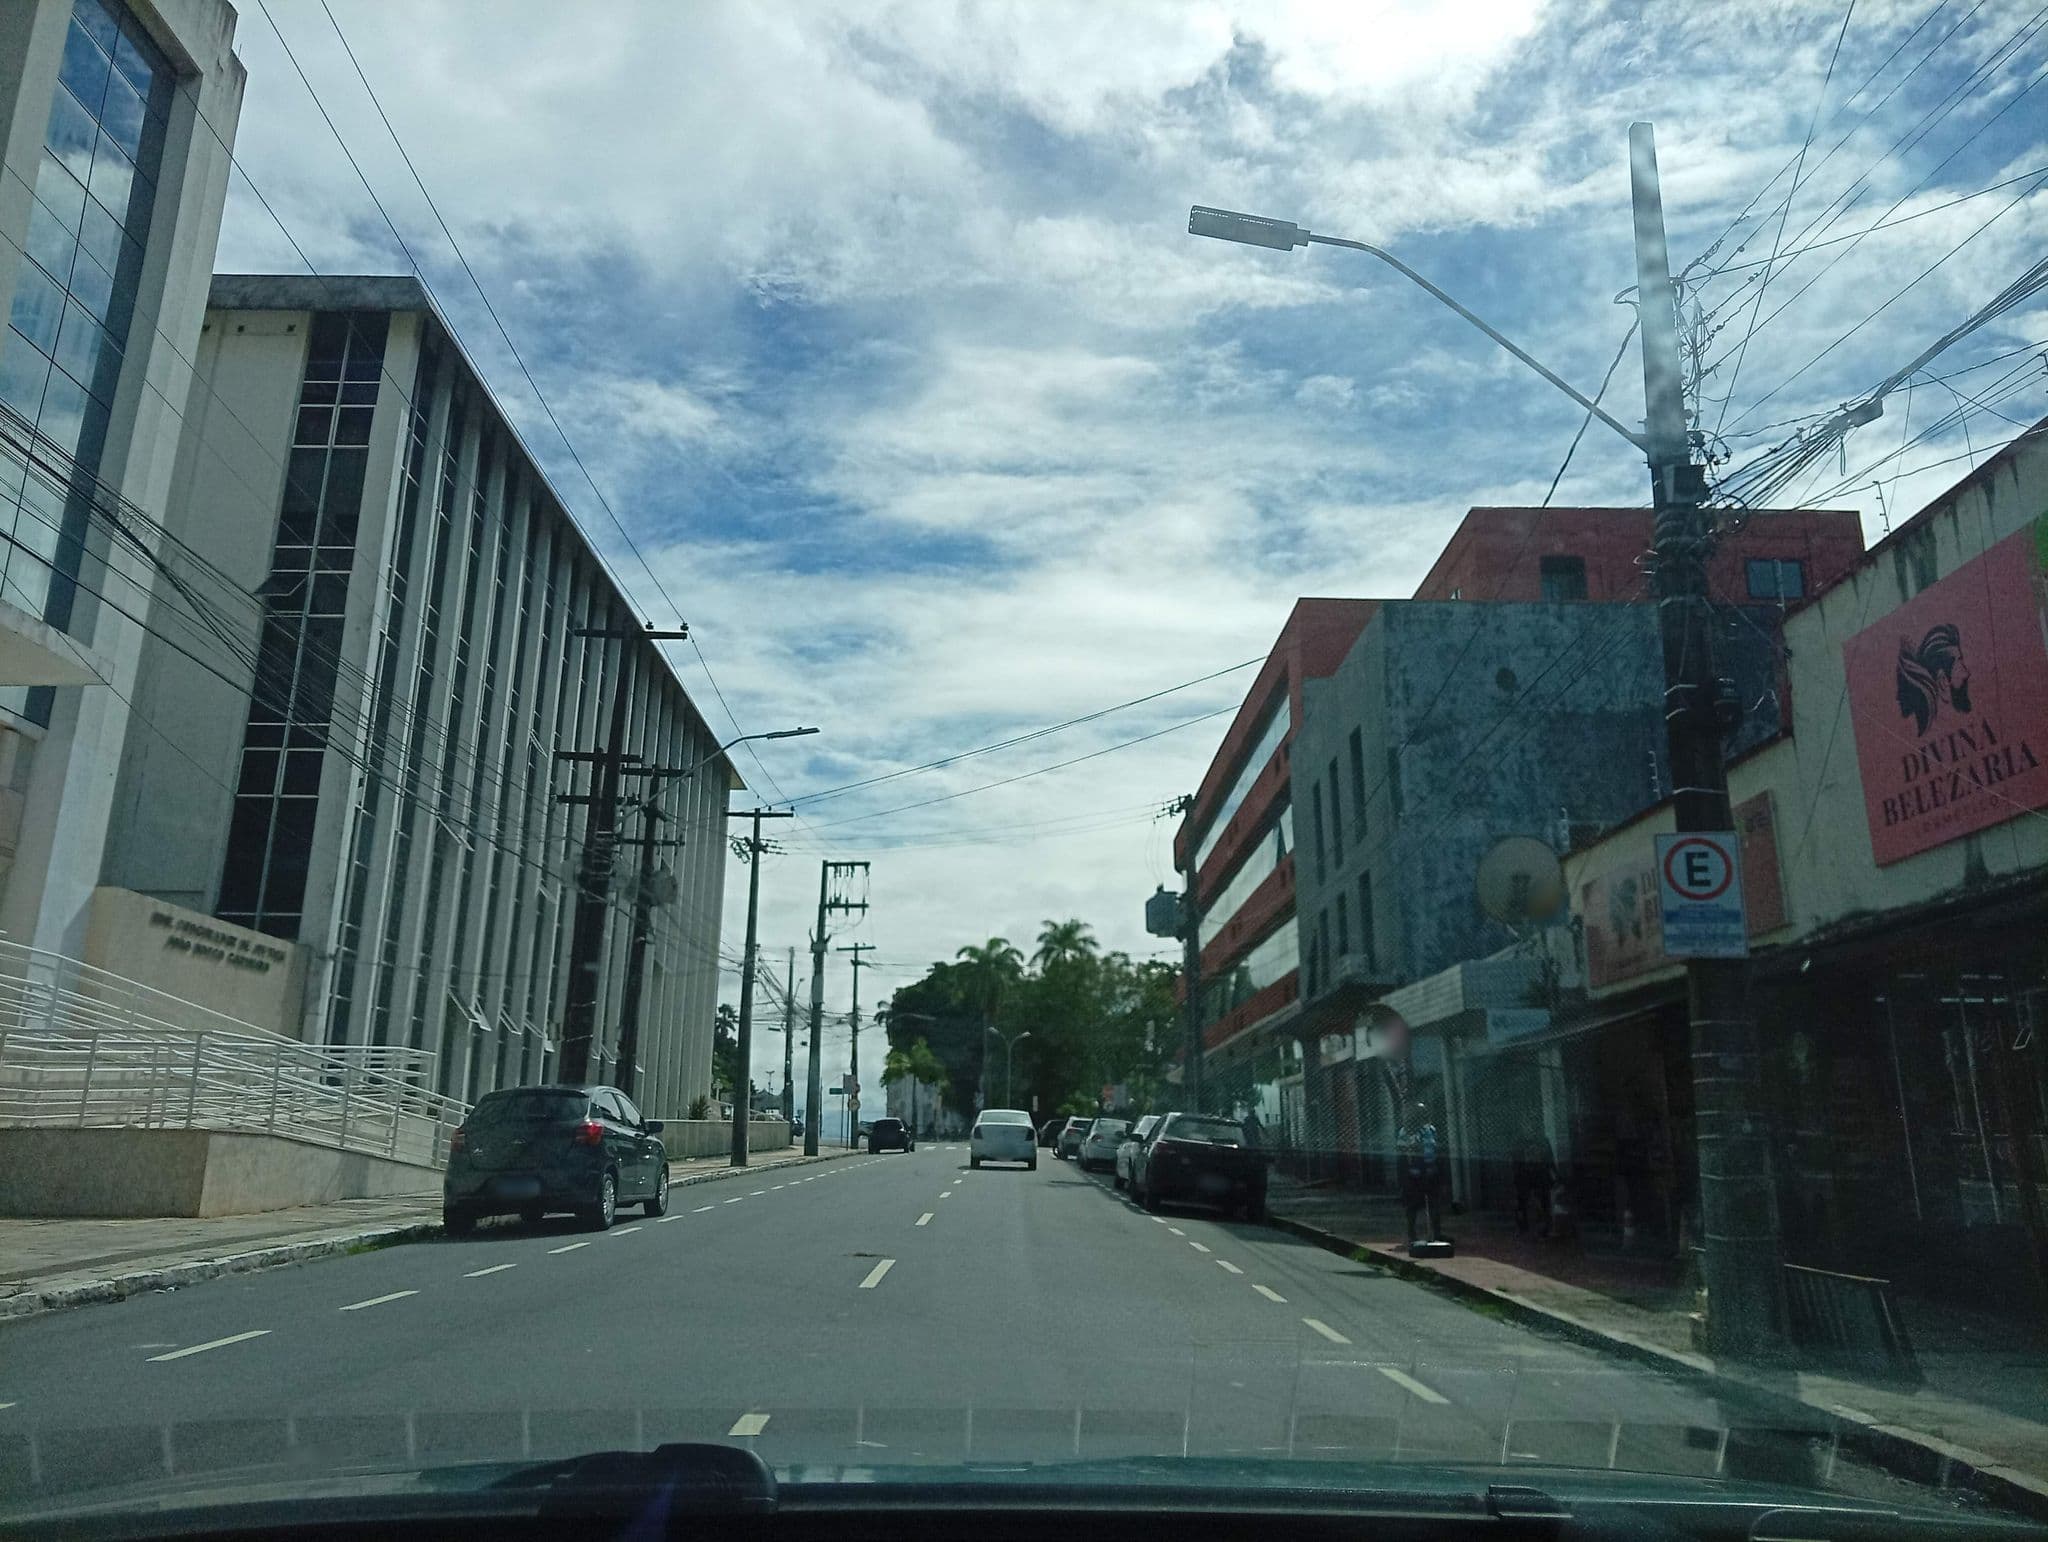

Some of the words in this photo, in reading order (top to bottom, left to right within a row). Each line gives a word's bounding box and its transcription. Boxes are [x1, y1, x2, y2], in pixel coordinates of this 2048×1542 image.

[1901, 717, 1998, 782] DIVINA
[1882, 739, 2040, 826] BELEZARIA
[1685, 852, 1712, 887] E
